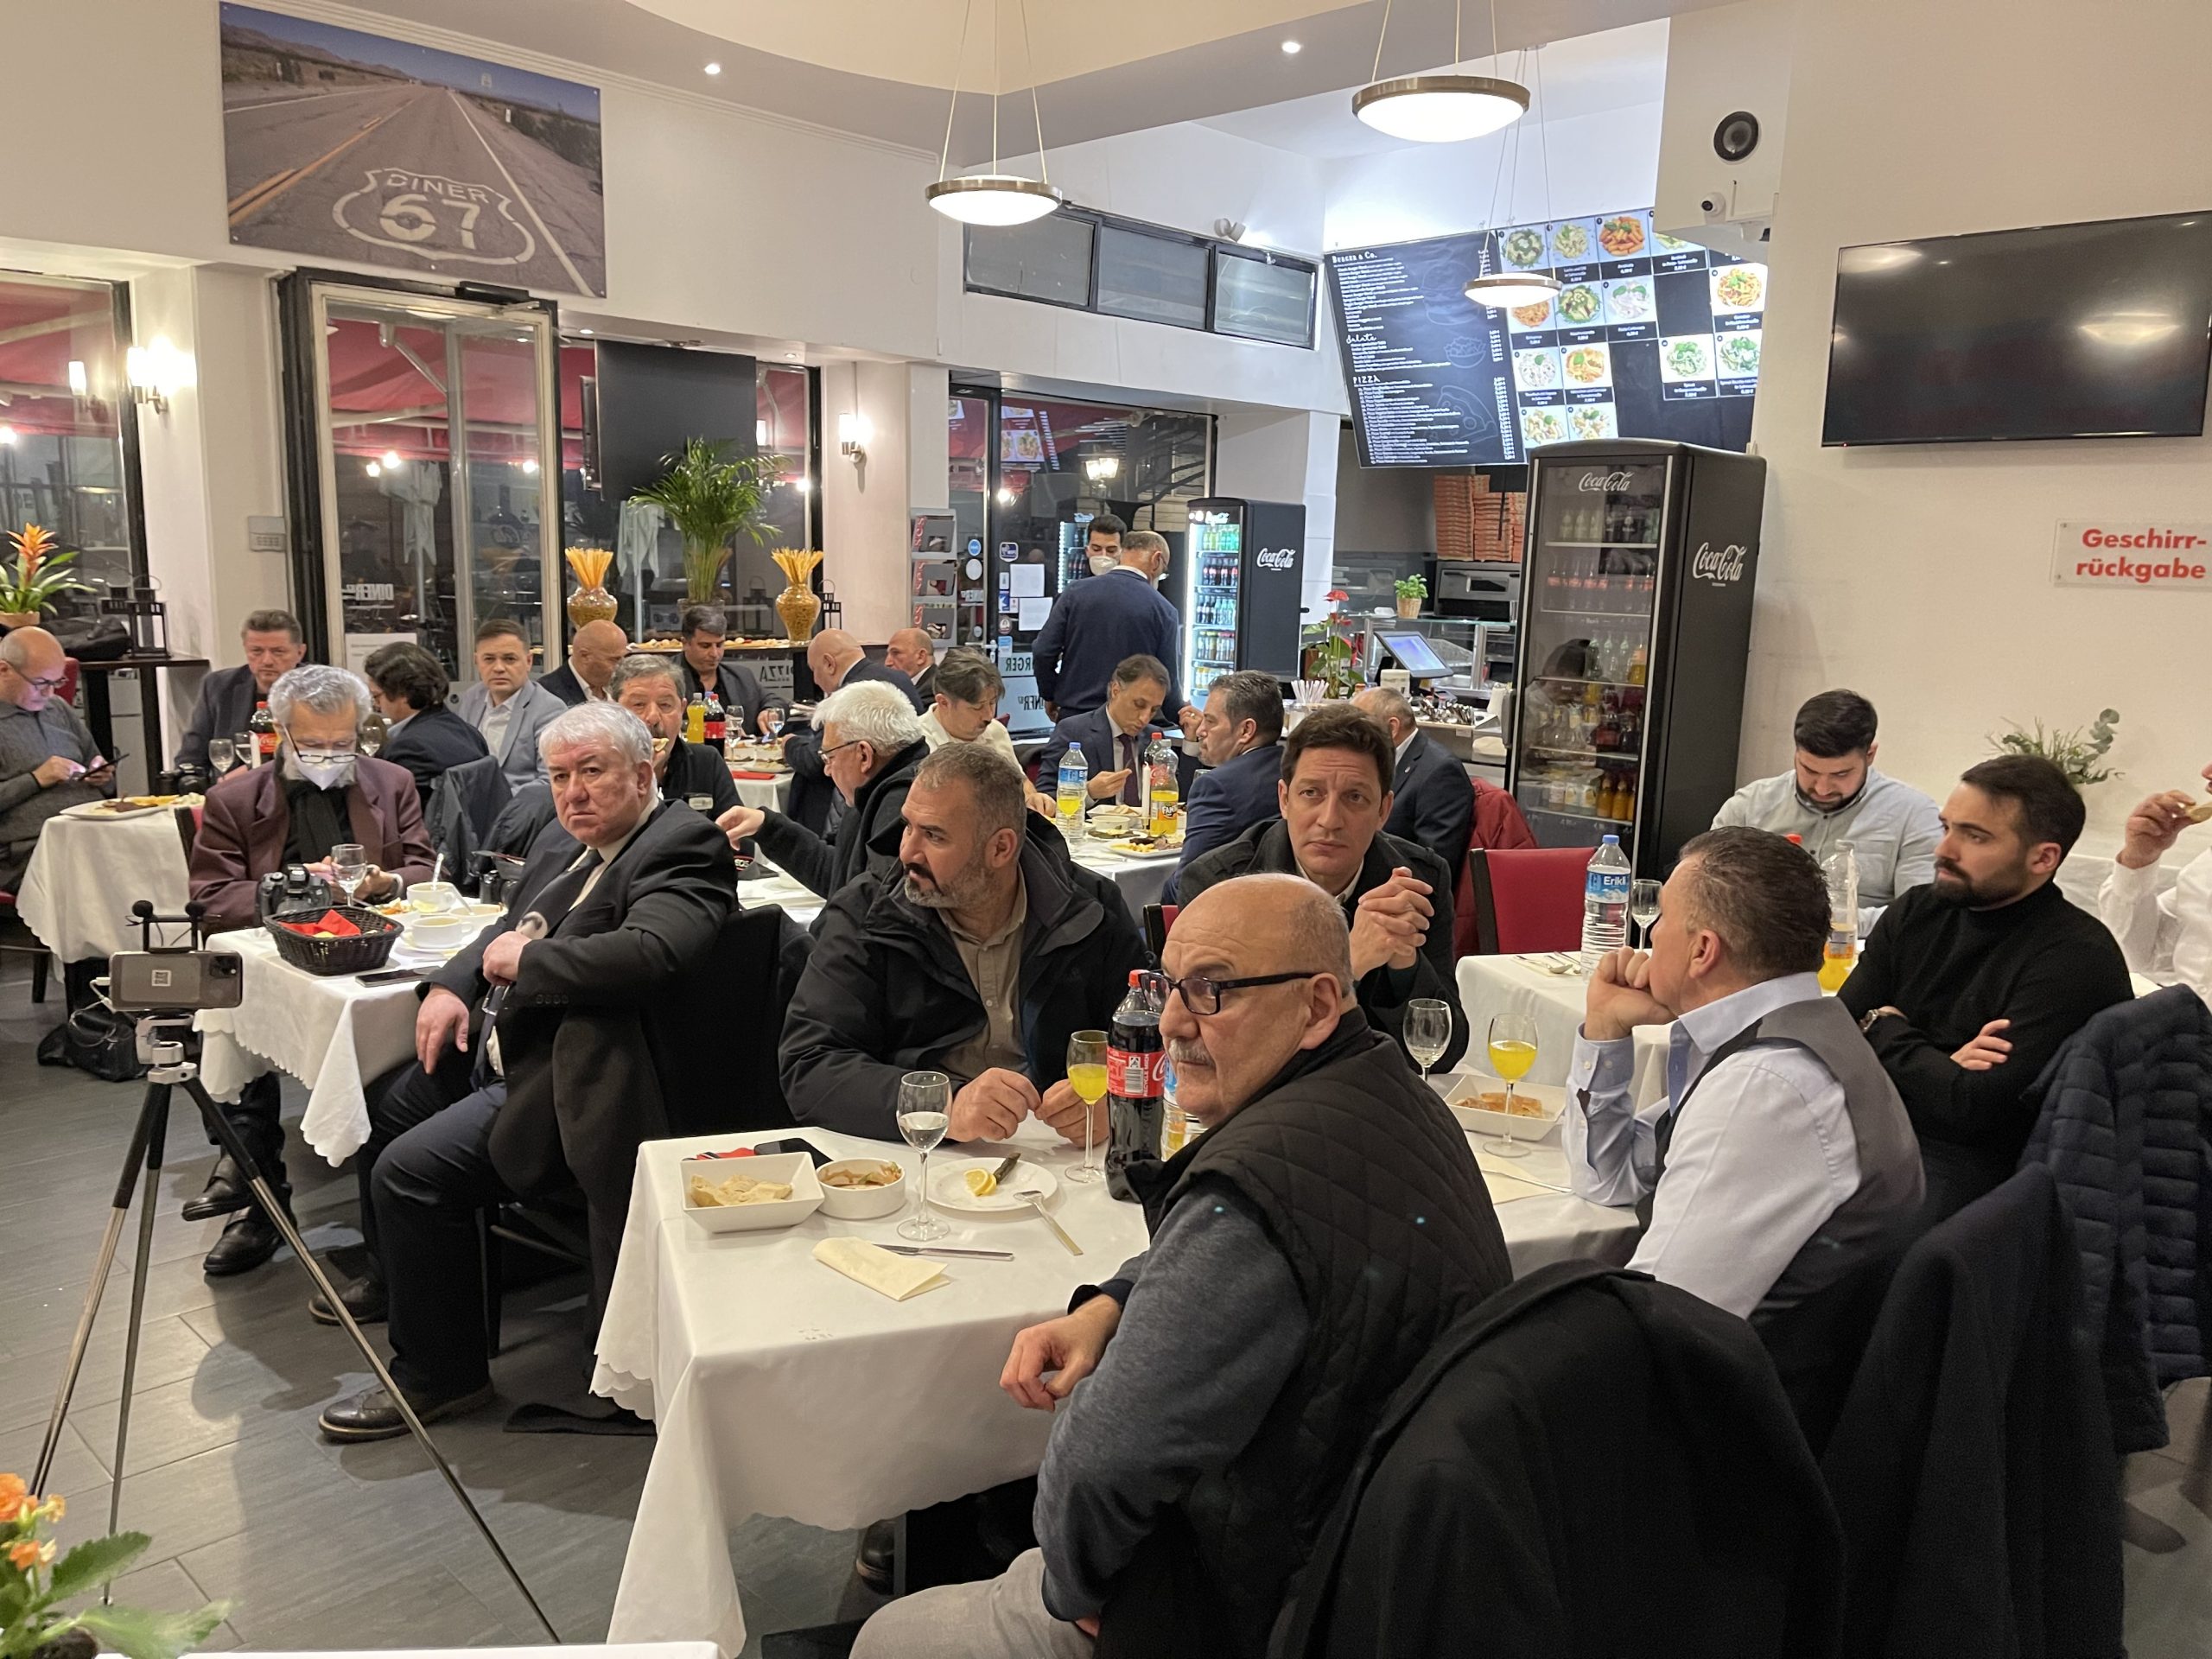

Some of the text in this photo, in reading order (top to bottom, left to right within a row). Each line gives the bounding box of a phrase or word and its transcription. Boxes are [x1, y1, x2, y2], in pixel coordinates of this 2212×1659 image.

[386, 173, 489, 204] DINER
[379, 194, 480, 250] 67
[1352, 375, 1381, 384] PIZZA
[1578, 471, 1635, 492] Coca-Cola
[2082, 527, 2207, 550] Geschirr-
[1256, 548, 1296, 569] Coca-Cola
[1692, 542, 1747, 582] Coca-Cola
[2075, 556, 2206, 583] rückgabe
